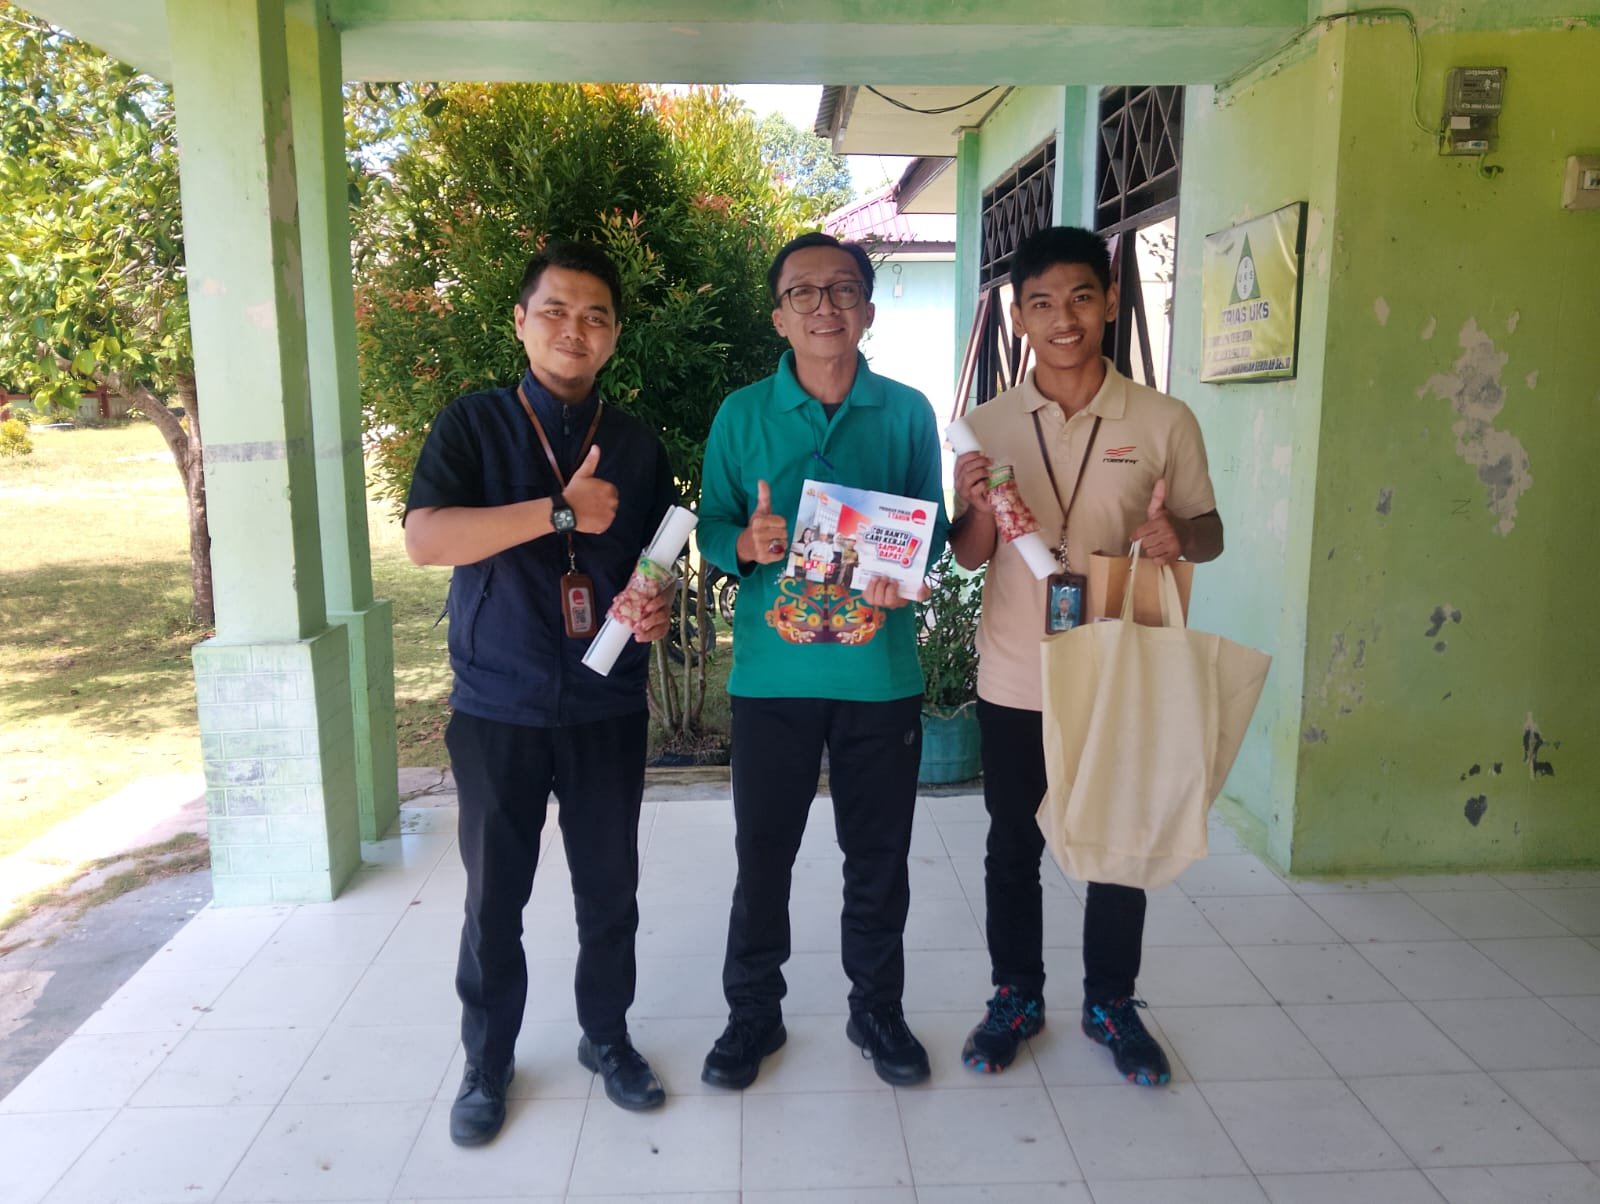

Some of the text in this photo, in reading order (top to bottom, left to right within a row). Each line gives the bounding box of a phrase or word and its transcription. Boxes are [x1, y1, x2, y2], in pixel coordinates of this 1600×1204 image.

[1223, 302, 1269, 325] TRIAS UKS
[864, 533, 906, 546] CARI KERJA
